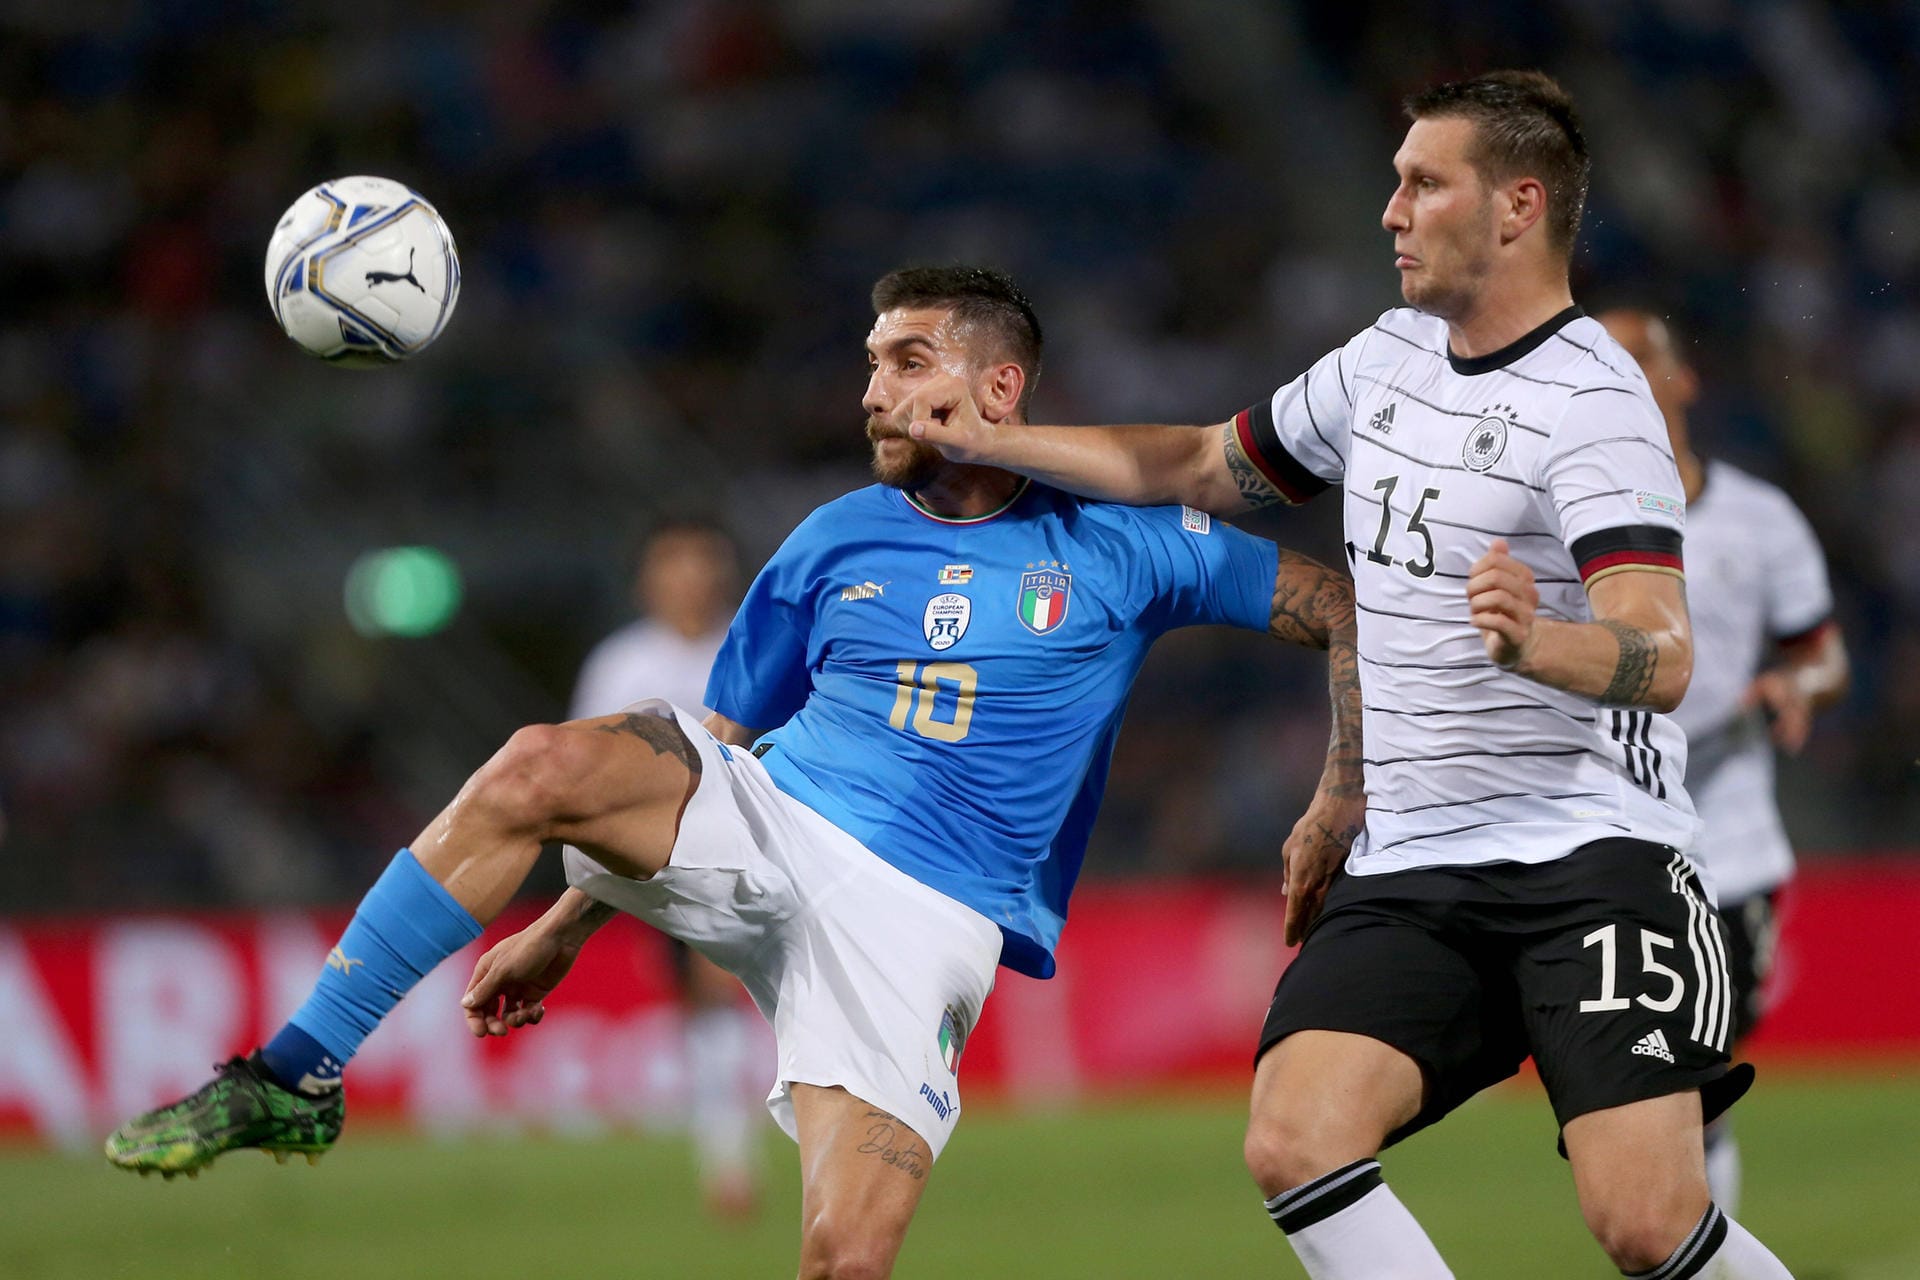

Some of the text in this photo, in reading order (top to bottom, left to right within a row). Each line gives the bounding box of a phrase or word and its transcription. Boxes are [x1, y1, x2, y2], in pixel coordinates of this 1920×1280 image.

[1367, 475, 1440, 578] 15
[1026, 575, 1067, 587] ITALIA
[889, 659, 977, 743] 10
[1580, 923, 1685, 1013] 15
[1631, 1043, 1675, 1064] adidas
[919, 1082, 948, 1121] PUMA
[858, 1123, 924, 1180] Destino
